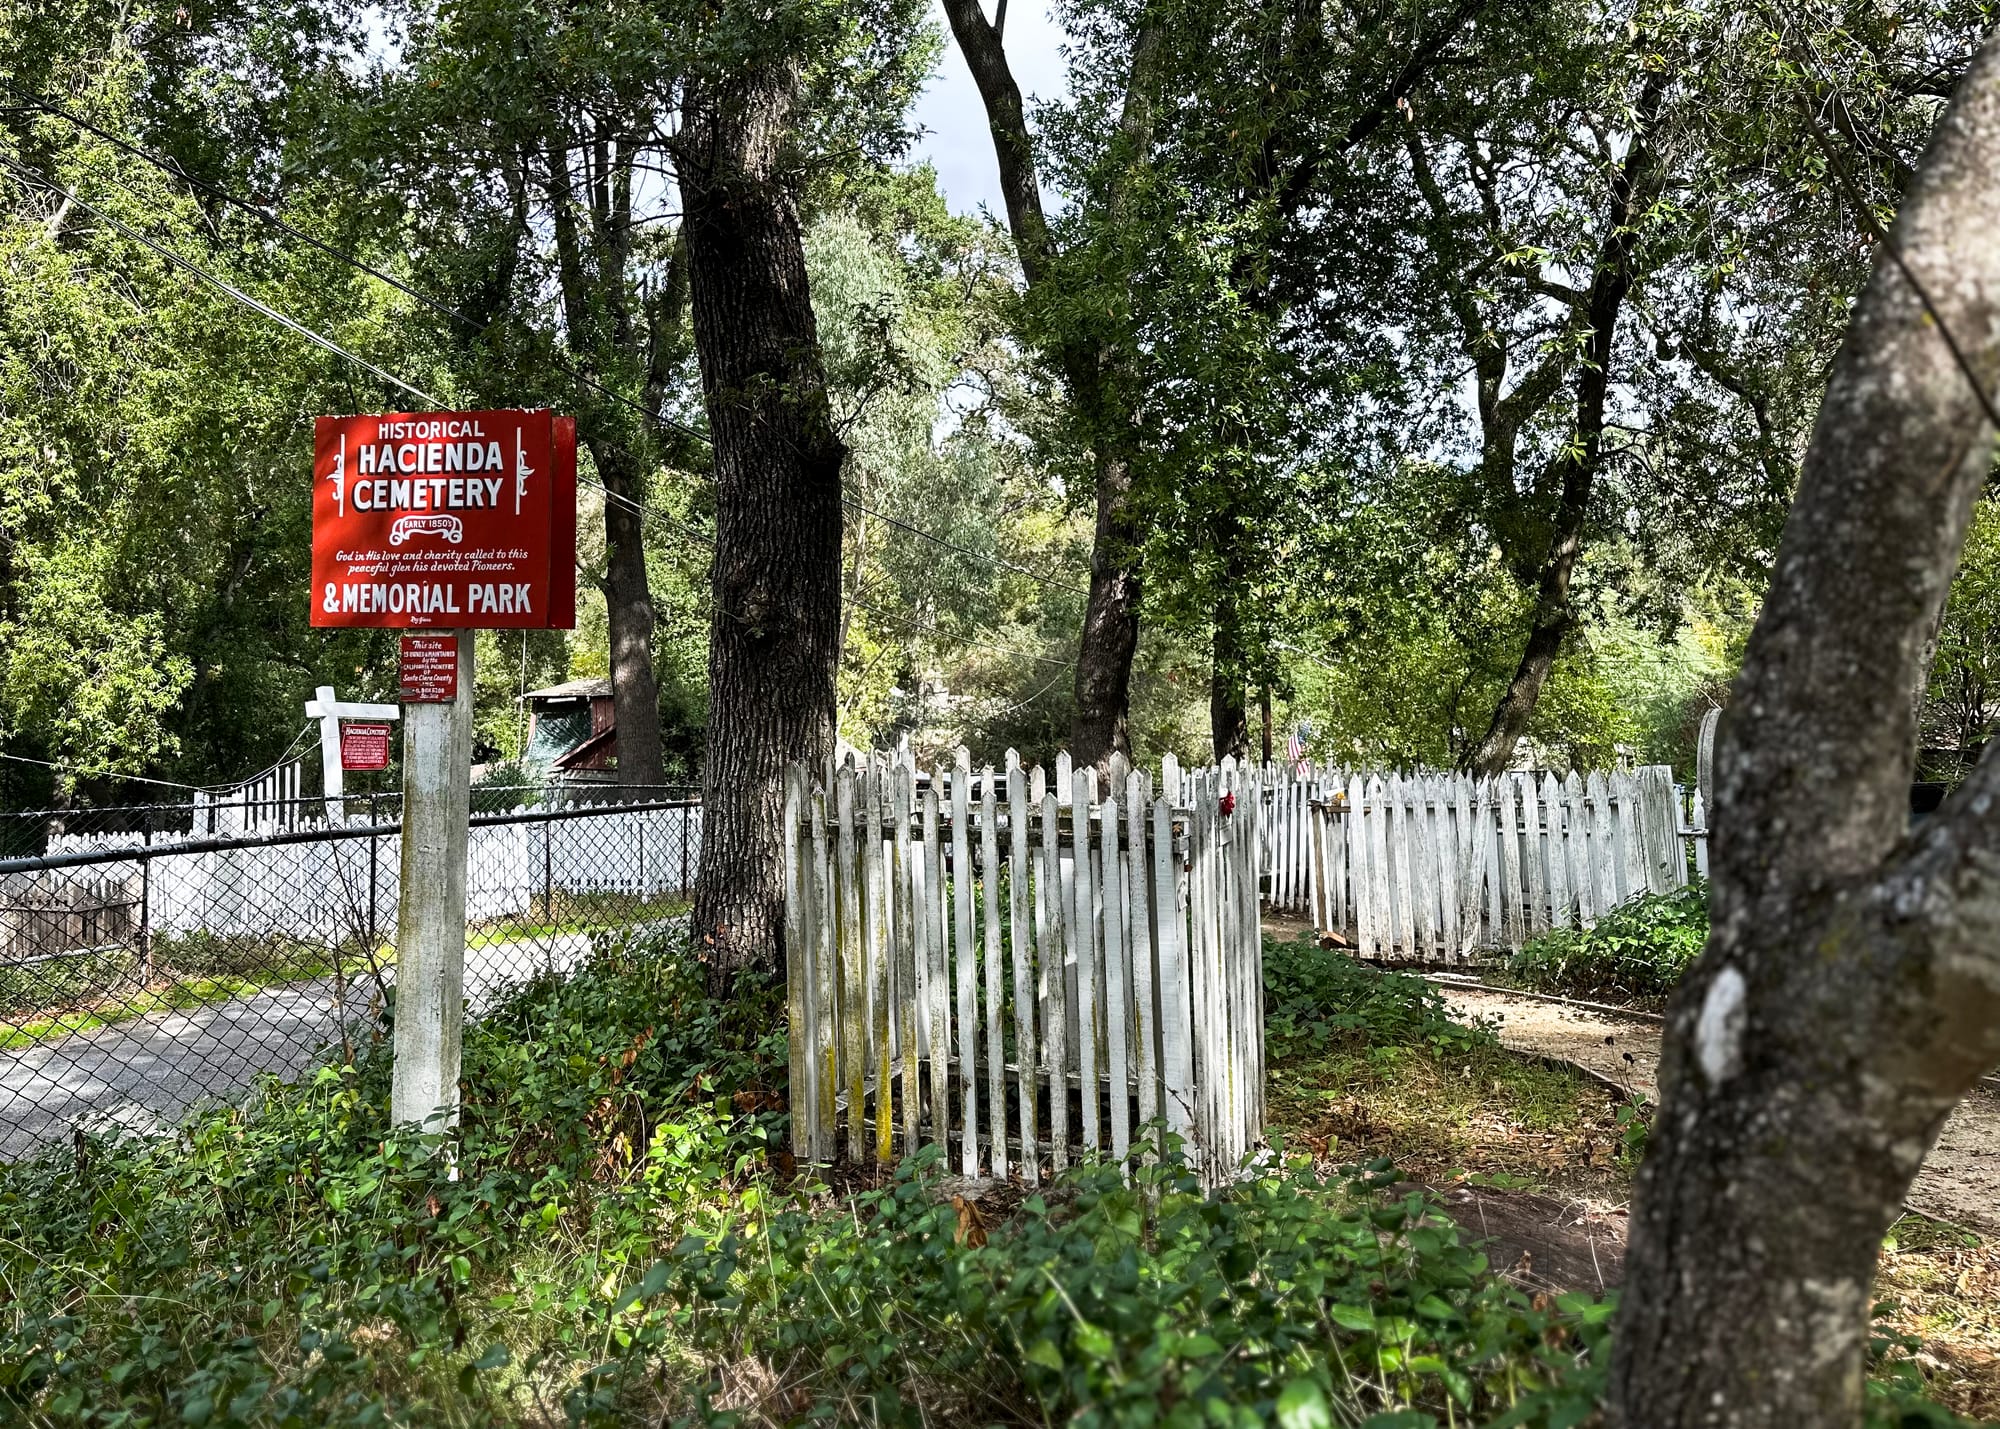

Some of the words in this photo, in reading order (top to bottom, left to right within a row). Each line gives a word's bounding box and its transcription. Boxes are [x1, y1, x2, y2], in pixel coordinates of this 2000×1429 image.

[378, 420, 485, 440] HISTORICAL
[358, 441, 503, 474] HACIENDA
[353, 478, 503, 512] CEMETERY
[404, 520, 426, 528] EARLY
[336, 551, 354, 562] God
[355, 551, 365, 561] in
[365, 550, 381, 561] His
[382, 550, 401, 561] love
[403, 550, 422, 560] and
[425, 549, 462, 564] charity
[464, 549, 494, 560] called
[496, 550, 506, 559] to
[507, 549, 528, 559] this
[347, 560, 389, 576] peaceful
[389, 562, 411, 576] glen
[413, 561, 428, 572] his
[430, 561, 470, 571] devoted
[471, 560, 515, 571] Pioneers.
[323, 583, 340, 613] &
[343, 583, 459, 613] MEMORIAL
[468, 583, 531, 613] PARK
[412, 640, 427, 649] This
[434, 674, 453, 684] County
